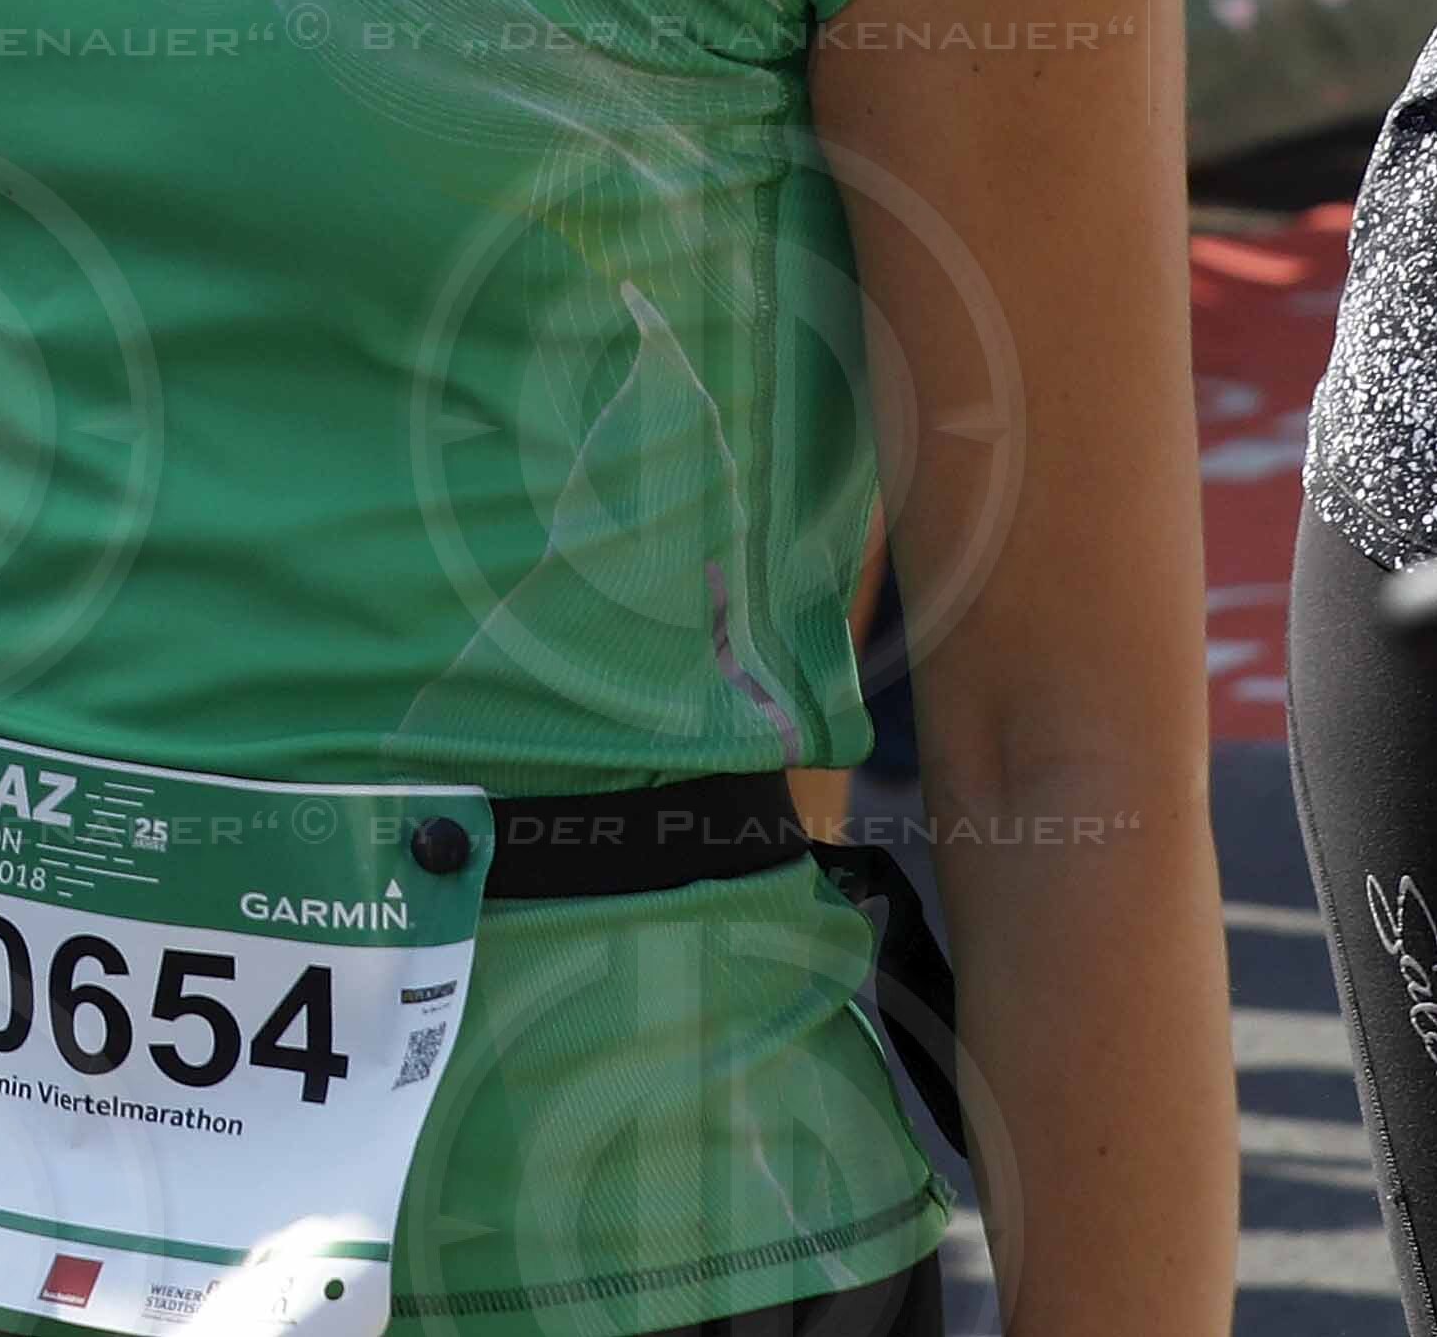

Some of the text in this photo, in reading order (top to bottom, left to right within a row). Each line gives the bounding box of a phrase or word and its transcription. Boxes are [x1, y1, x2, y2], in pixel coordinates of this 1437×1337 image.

[134, 817, 169, 842] 25
[239, 891, 409, 931] GARMIN
[37, 1079, 245, 1138] Viertelmarathon
[150, 1283, 203, 1302] WIENER
